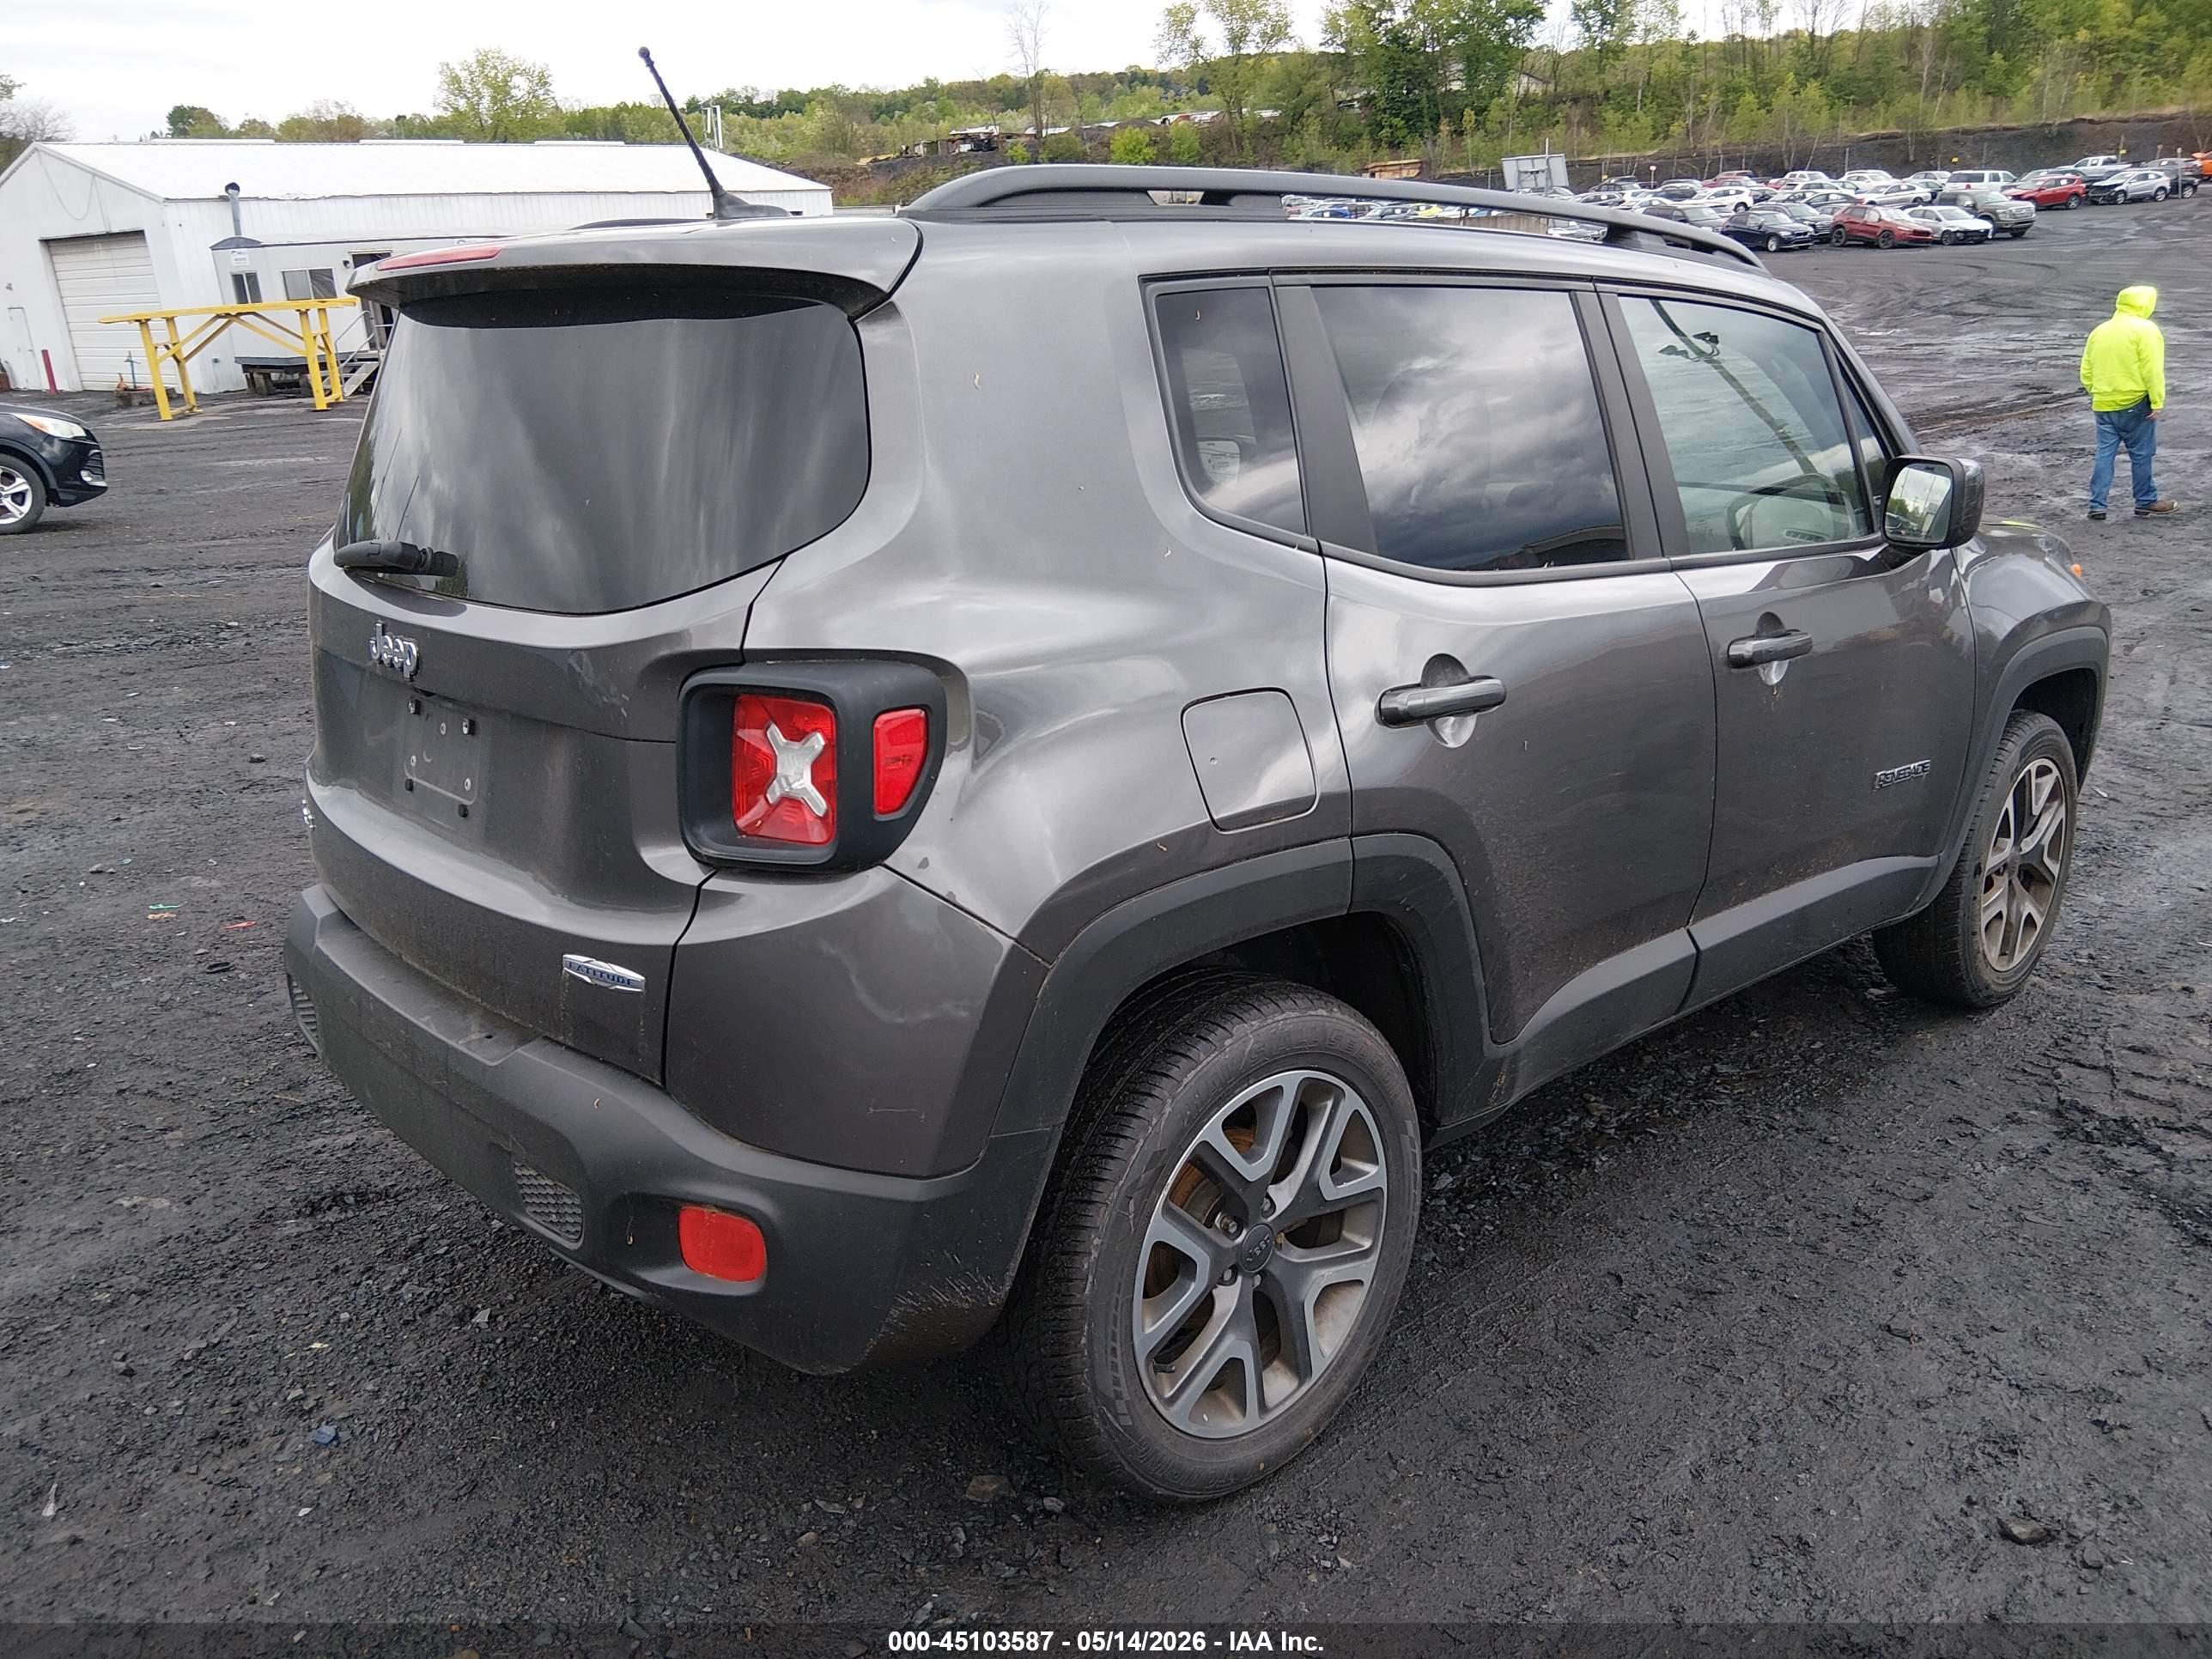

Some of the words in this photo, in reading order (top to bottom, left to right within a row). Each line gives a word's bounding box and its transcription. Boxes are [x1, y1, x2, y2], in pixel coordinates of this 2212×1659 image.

[368, 620, 418, 681] Jeep
[1874, 759, 1931, 789] RENEGADE
[568, 961, 634, 986] LATITUDE
